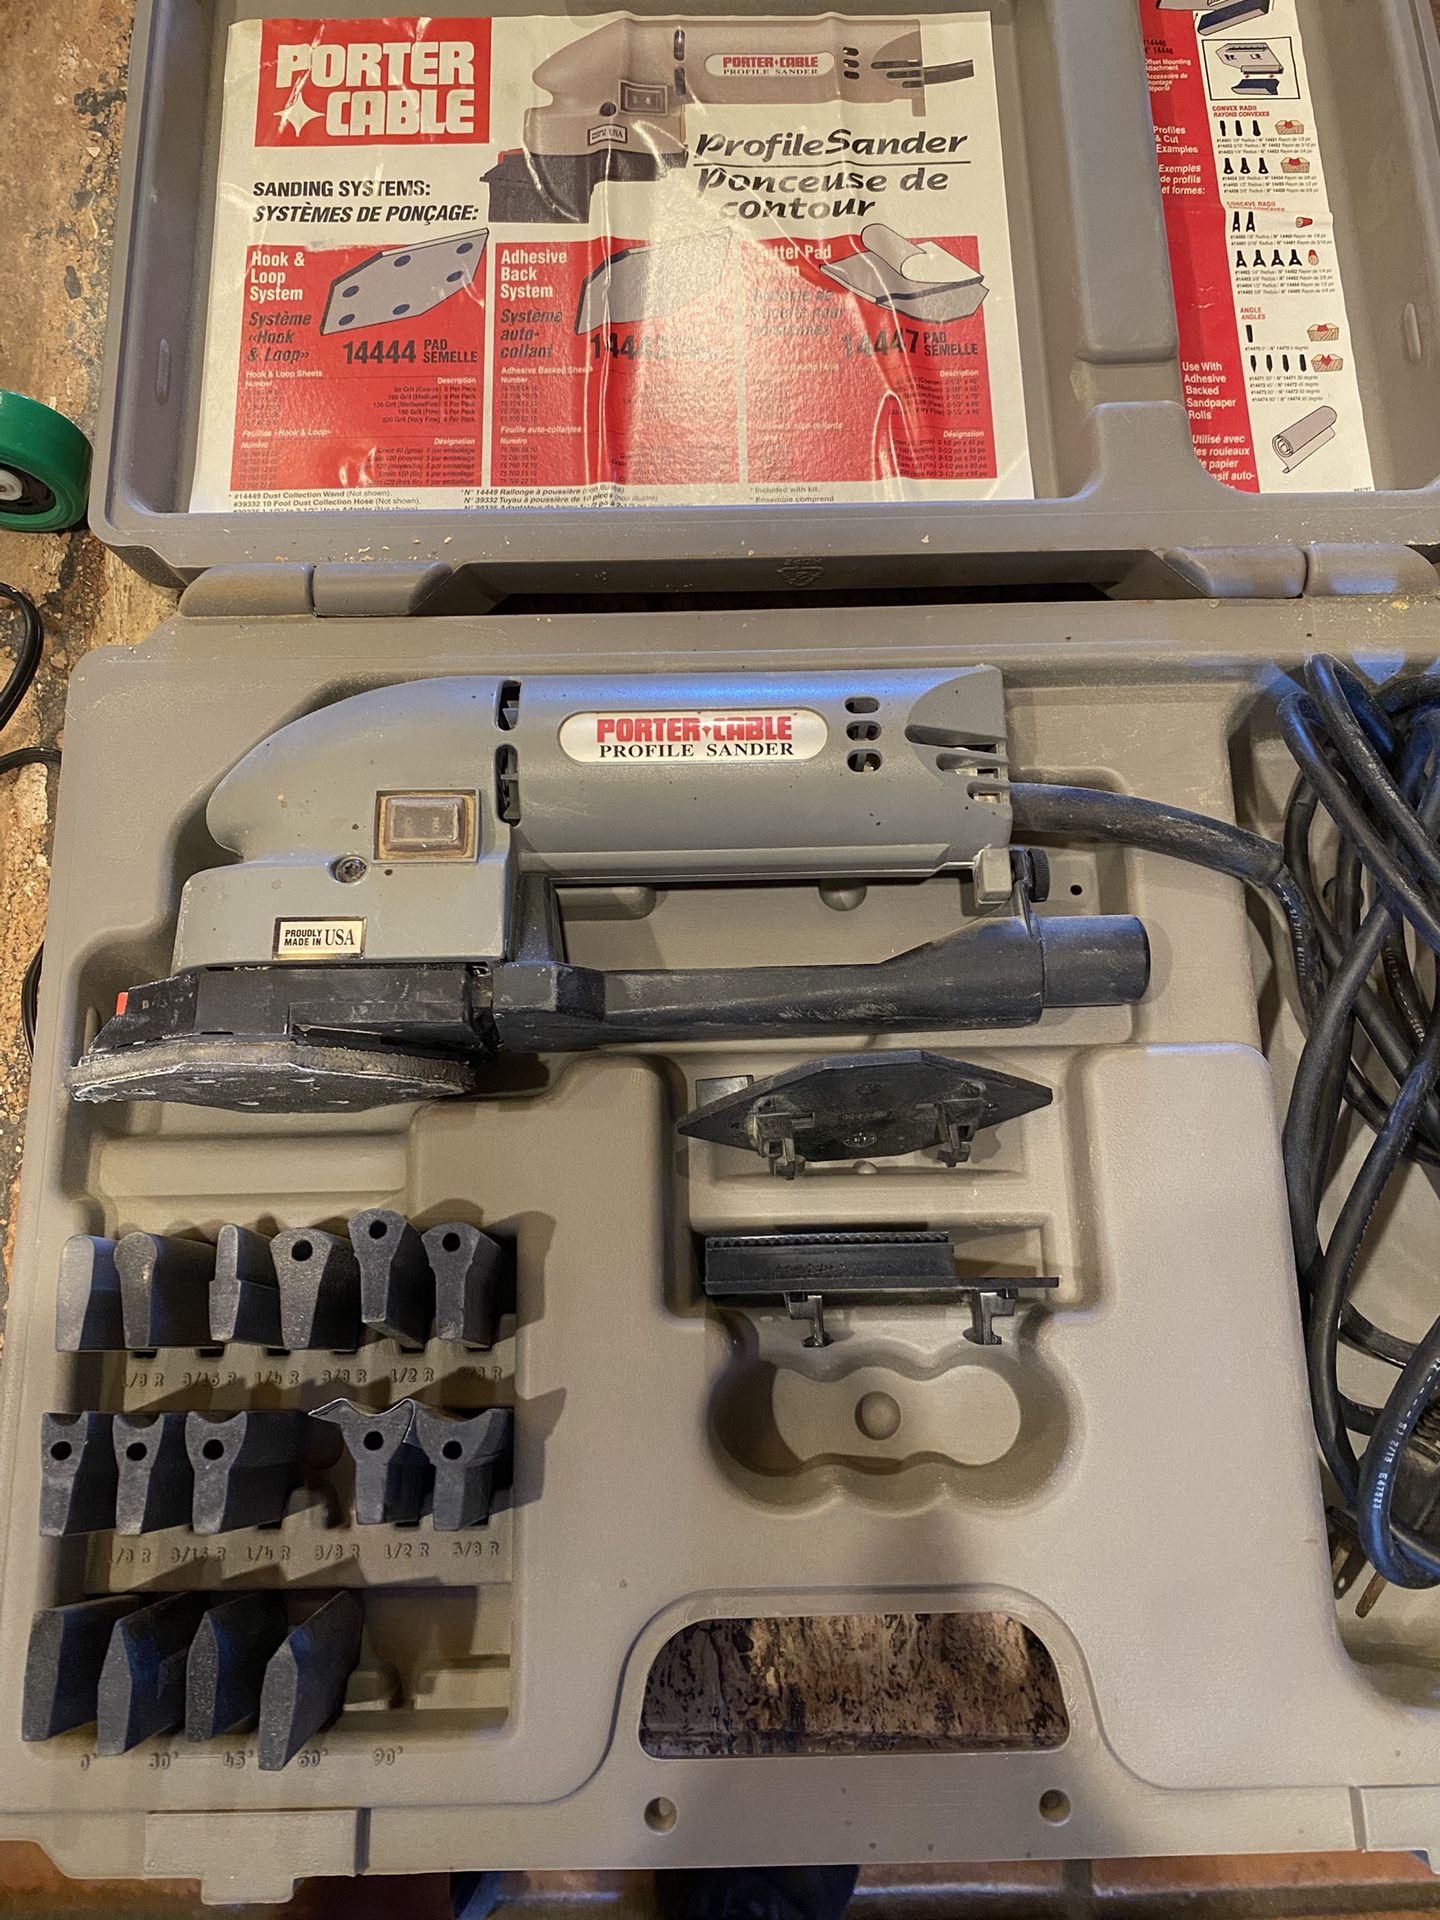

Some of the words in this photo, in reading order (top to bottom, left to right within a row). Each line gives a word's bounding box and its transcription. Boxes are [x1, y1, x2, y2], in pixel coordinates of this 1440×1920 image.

[276, 41, 474, 88] PORTER
[722, 57, 774, 68] PORTER
[779, 56, 819, 67] CABLE
[722, 68, 771, 76] PROFILE
[325, 90, 474, 137] CABLE
[1153, 126, 1186, 135] Profiles
[1156, 145, 1199, 155] Examples
[1158, 164, 1201, 174] Exemples
[696, 167, 887, 198] Ponceuse
[899, 167, 949, 191] de
[1160, 175, 1171, 183] de
[1172, 175, 1201, 184] profils
[253, 180, 334, 197] SANDING
[338, 179, 431, 196] SYSTEMS:
[1161, 186, 1170, 194] et
[1172, 186, 1206, 195] formes:
[253, 201, 352, 223] SYSTÈMES
[358, 205, 381, 222] DE
[385, 204, 479, 226] PONÇAGE:
[721, 197, 876, 219] contour
[252, 251, 289, 266] Hook
[293, 251, 305, 266] &
[501, 249, 567, 264] Adhesive
[804, 244, 832, 259] Pad
[250, 268, 286, 286] Loop
[501, 267, 537, 281] Back
[250, 286, 303, 304] System
[500, 284, 553, 301] System
[249, 311, 312, 327] Système
[500, 308, 563, 324] Système
[500, 327, 539, 340] auto-
[923, 332, 947, 343] PAD
[423, 339, 448, 350] PAD
[500, 343, 553, 358] collant
[841, 329, 920, 358] 14447
[923, 343, 979, 356] SEMELLE
[247, 348, 258, 362] &
[342, 340, 417, 364] 14444
[423, 351, 478, 363] SEMELLE
[940, 369, 979, 377] Description
[1182, 362, 1199, 371] Use
[1200, 362, 1222, 371] With
[276, 370, 295, 378] Loop
[1184, 374, 1226, 383] Adhesive
[246, 380, 273, 388] Number
[1186, 385, 1219, 395] Backed
[1187, 398, 1236, 409] Sandpaper
[1189, 410, 1212, 420] Rolls
[434, 437, 475, 446] Désignation
[1192, 434, 1221, 444] Utilisé
[1223, 435, 1245, 443] avec
[1209, 446, 1250, 456] rouleaux
[1208, 459, 1238, 471] papier
[1231, 472, 1255, 480] auto-
[262, 491, 281, 499] Dust
[283, 490, 320, 498] Collection
[322, 489, 345, 497] Wand
[346, 489, 361, 498] (Not
[475, 488, 498, 496] 14449
[500, 488, 532, 498] Rallonge
[542, 488, 581, 497] poussière
[476, 496, 498, 504] 39332
[499, 496, 521, 505] Tuyau
[529, 496, 569, 505] poussière
[571, 495, 581, 503] de
[583, 494, 591, 502] 10
[795, 495, 834, 504] comprend
[273, 499, 290, 507] Foot
[292, 499, 311, 507] Dust
[313, 499, 351, 507] Collection
[353, 498, 374, 506] Hose
[597, 718, 700, 743] PORTER
[712, 716, 792, 741] CABLE
[600, 743, 694, 758] PROFILE
[706, 742, 794, 756] SANDER
[285, 928, 323, 938] PROUDLY
[325, 928, 355, 946] USA
[284, 938, 309, 946] MADE
[312, 938, 321, 946] IN
[154, 1373, 164, 1387] R
[227, 1371, 237, 1386] R
[289, 1370, 300, 1386] R
[356, 1369, 367, 1384] R
[390, 1368, 417, 1384] 1/2
[423, 1367, 434, 1382] R
[492, 1366, 502, 1381] R
[141, 1548, 151, 1563] R
[216, 1546, 226, 1561] R
[280, 1545, 291, 1561] R
[314, 1544, 342, 1560] 3/8
[349, 1544, 360, 1560] R
[383, 1543, 410, 1559] 1/2
[418, 1542, 430, 1558] R
[489, 1541, 499, 1556] R
